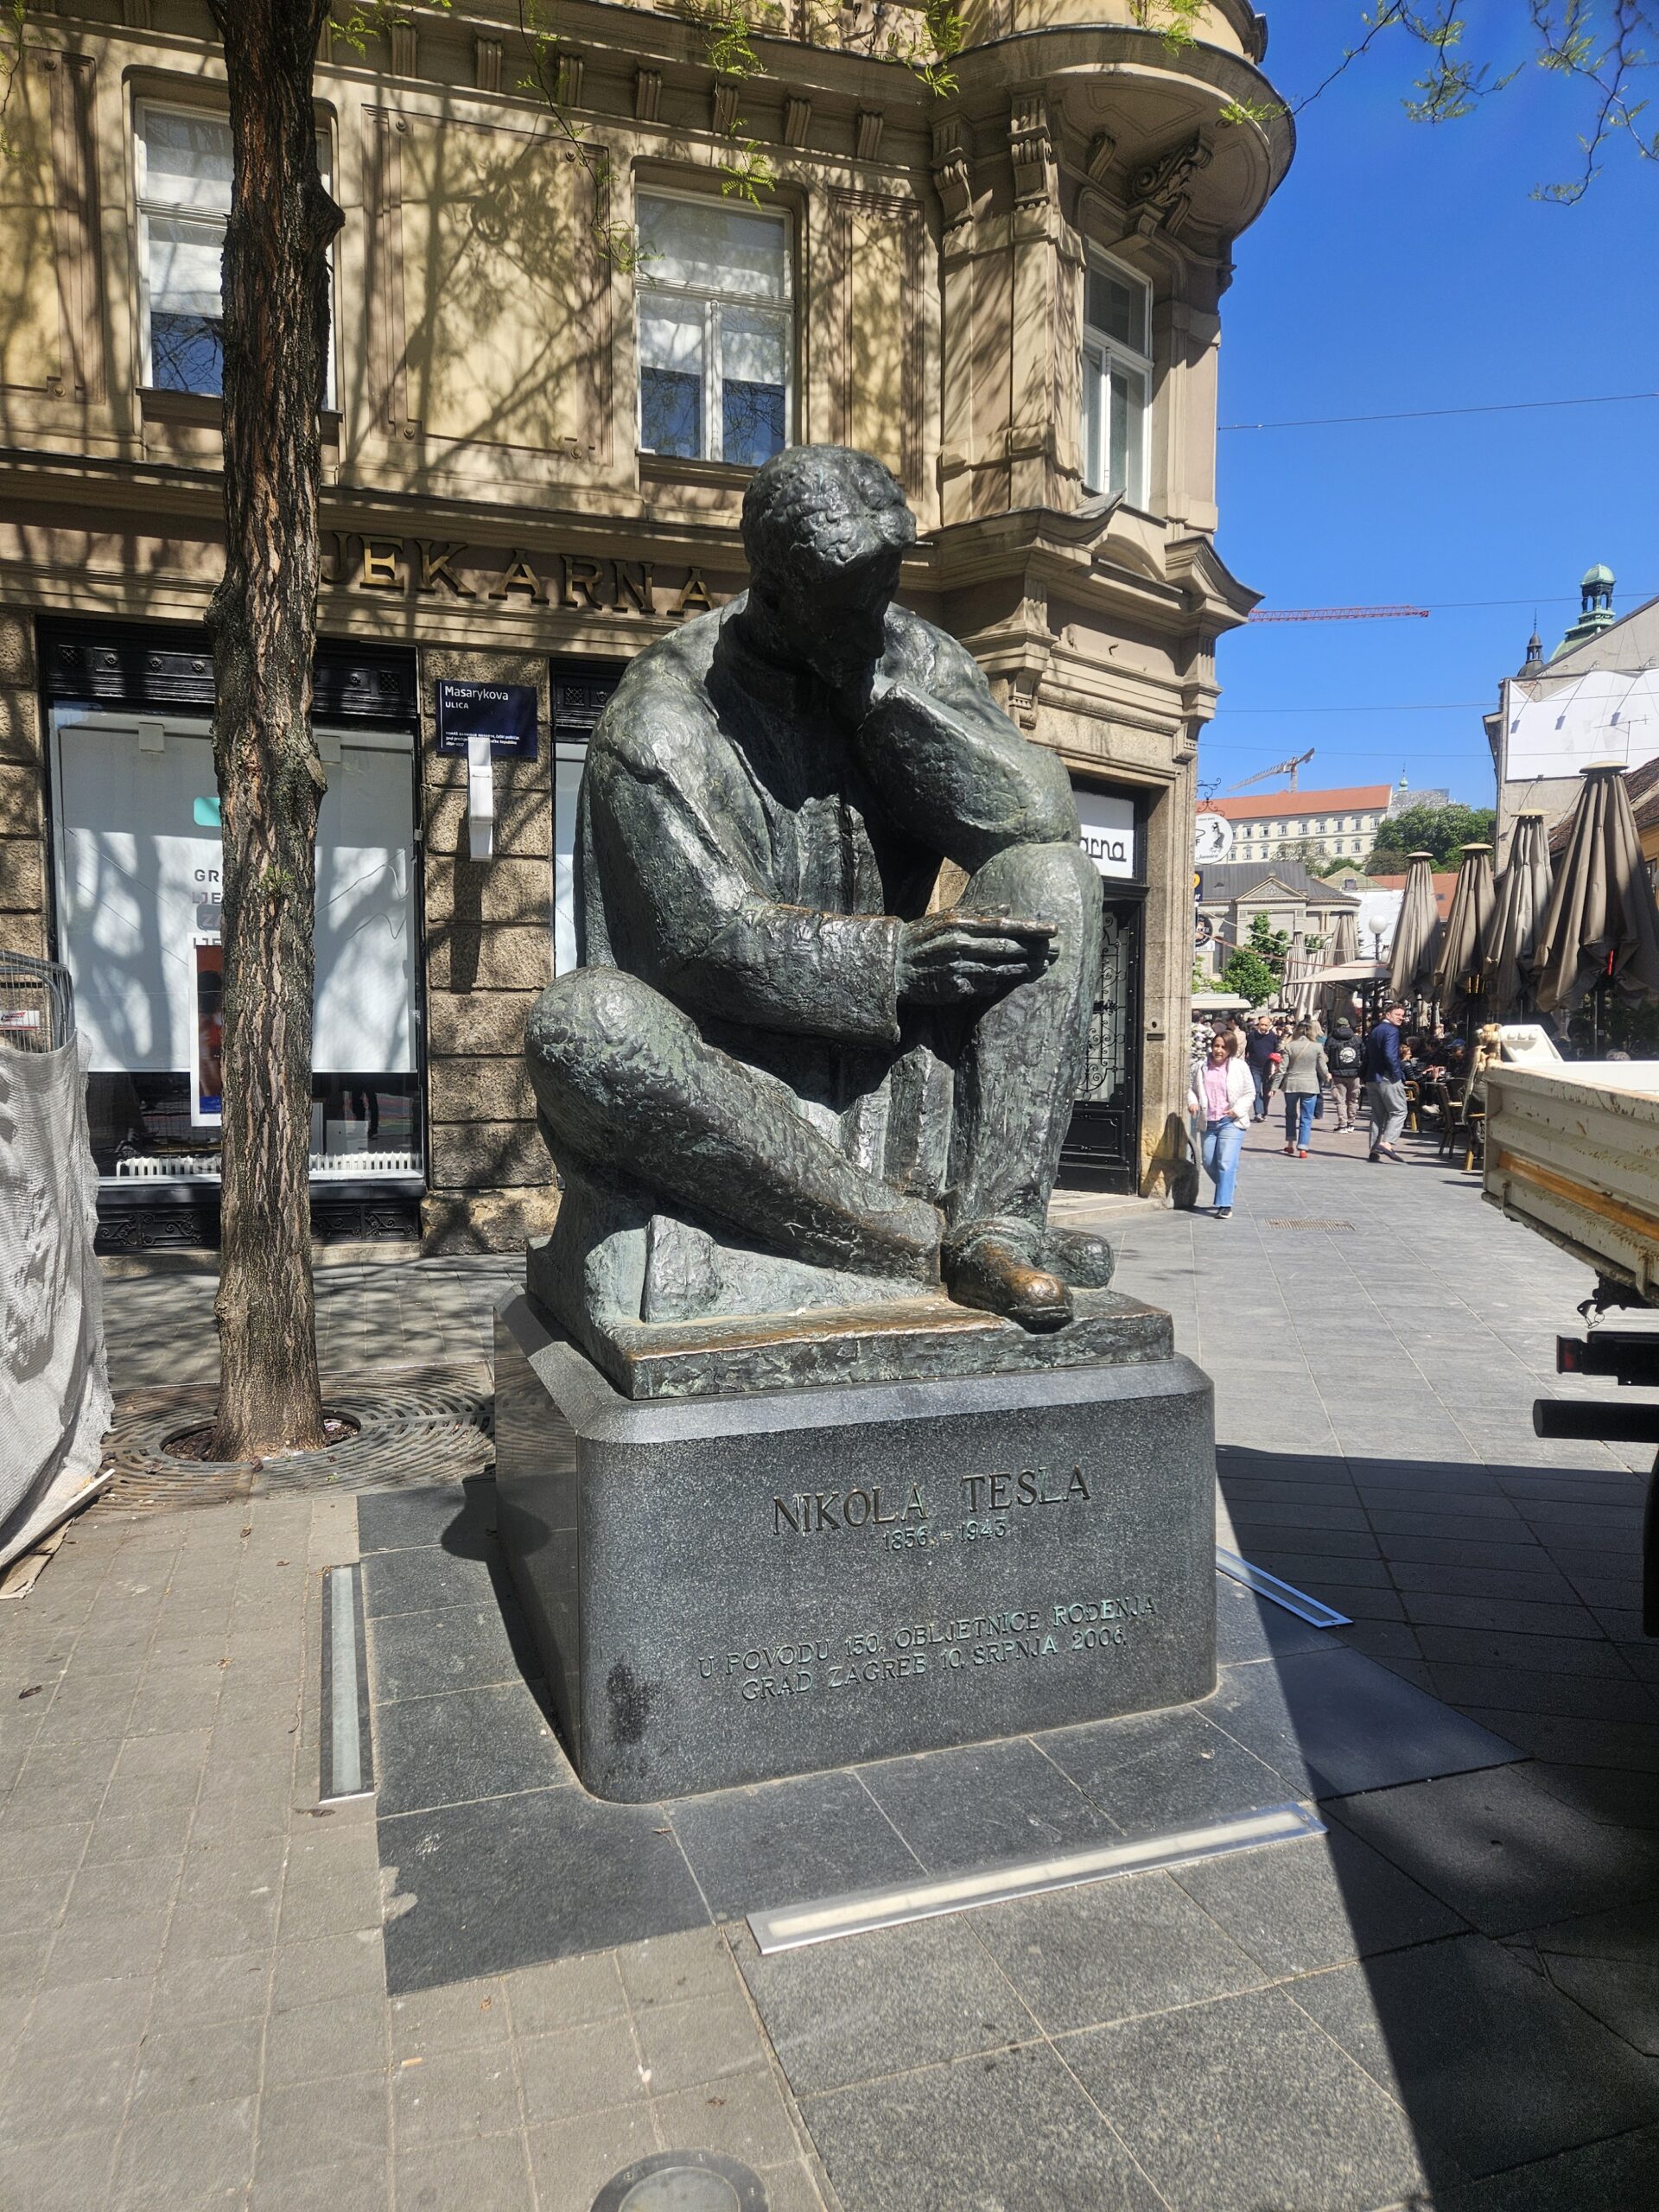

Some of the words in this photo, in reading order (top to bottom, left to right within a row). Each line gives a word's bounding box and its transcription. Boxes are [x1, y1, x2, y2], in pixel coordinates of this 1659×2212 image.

[321, 531, 715, 615] JEKARNA
[444, 685, 509, 702] Masarykova
[445, 701, 469, 709] ULICA
[1079, 836, 1127, 862] arna
[194, 868, 219, 882] GR
[192, 891, 222, 905] LJE
[773, 1482, 929, 1536] NIKOLA
[960, 1465, 1091, 1512] TESLA
[698, 1656, 715, 1678] U
[726, 1640, 830, 1675] POVODU
[844, 1633, 887, 1658] 150.
[895, 1611, 1039, 1649] OBLJETNICE
[741, 1670, 813, 1700] GRAD
[828, 1653, 927, 1688] ZAGREB
[940, 1649, 965, 1670] 10.
[973, 1634, 1058, 1666] SRPNJA
